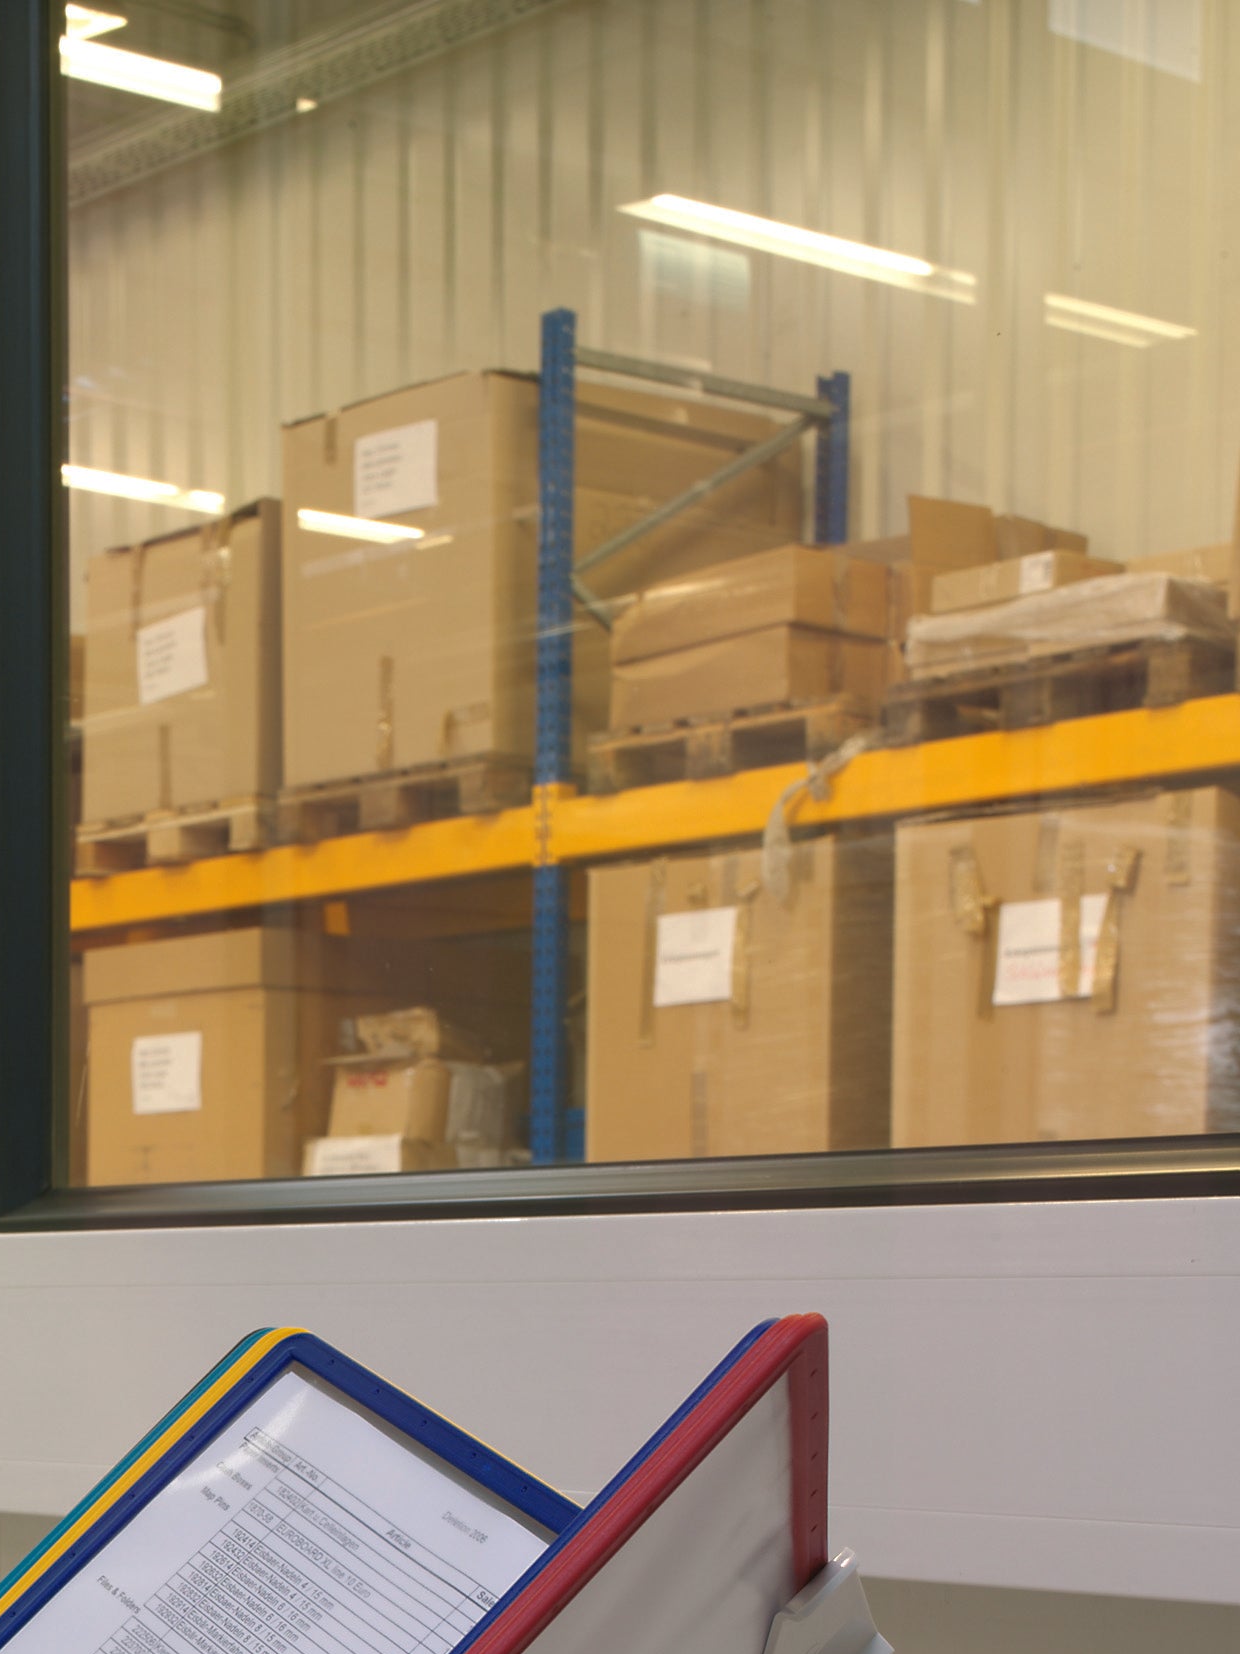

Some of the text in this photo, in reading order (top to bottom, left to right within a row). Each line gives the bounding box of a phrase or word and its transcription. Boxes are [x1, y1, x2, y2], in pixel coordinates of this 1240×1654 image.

[198, 1485, 232, 1512] Map Pins
[275, 1523, 324, 1562] EUROBOARD
[319, 1556, 334, 1569] XL
[352, 1580, 373, 1598] Euro
[385, 1526, 414, 1550] Article
[468, 1527, 489, 1544] 2006
[96, 1574, 115, 1591] Files
[116, 1591, 143, 1615] Folders
[219, 1576, 269, 1618] Eisbaer-Nadeln
[283, 1628, 300, 1643] mm
[230, 1566, 281, 1607] Eisbaer-Nadeln
[294, 1617, 311, 1632] mm
[241, 1555, 292, 1596] Eisbaer-Nadeln
[306, 1606, 323, 1621] mm
[252, 1544, 304, 1585] Eisbaer-Nadeln
[318, 1595, 335, 1610] mm
[197, 1598, 246, 1640] Eisbaer-Nadeln
[208, 1587, 258, 1629] Eisbaer-Nadeln
[270, 1638, 287, 1653] mm
